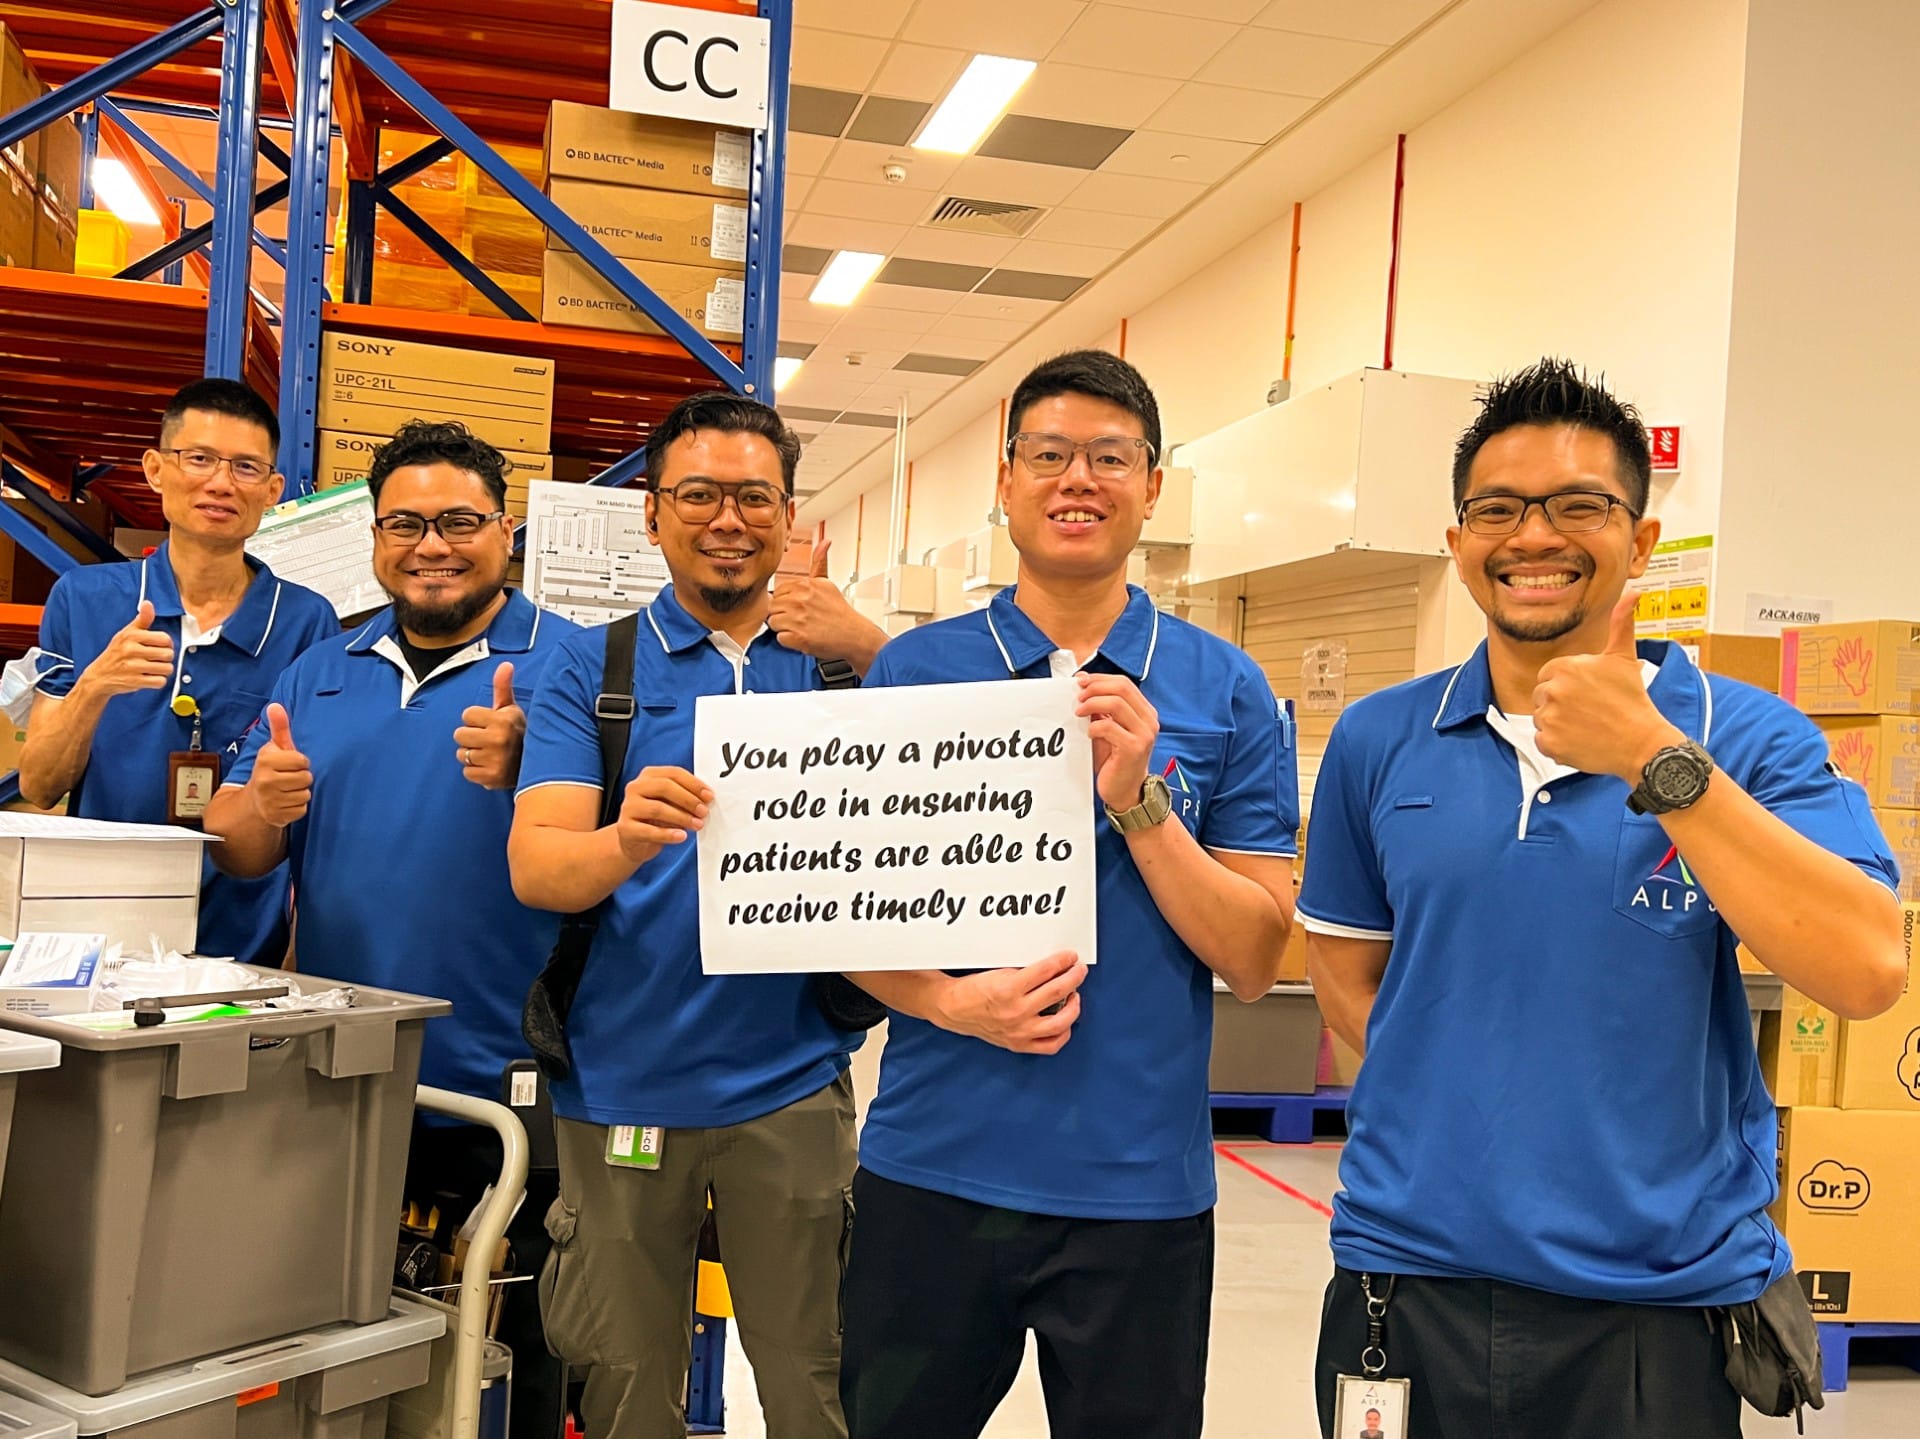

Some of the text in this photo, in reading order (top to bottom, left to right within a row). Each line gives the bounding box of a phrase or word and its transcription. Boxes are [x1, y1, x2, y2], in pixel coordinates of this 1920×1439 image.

[643, 29, 739, 99] CC
[577, 150, 591, 160] BD
[637, 159, 665, 171] Media
[635, 232, 663, 243] Media
[569, 297, 583, 307] BD
[337, 340, 396, 356] SONY
[334, 372, 397, 390] UPC-21L
[335, 438, 377, 453] SON
[1758, 607, 1821, 624] PACKAGING
[720, 728, 1064, 777] You play a pivotal
[754, 783, 1032, 820] role in ensuring
[721, 833, 1071, 881] patients are able to
[729, 886, 1066, 925] receive timely care!
[1631, 885, 1718, 913] ALP
[1809, 1180, 1861, 1200] Dr.P
[1812, 1273, 1830, 1301] L
